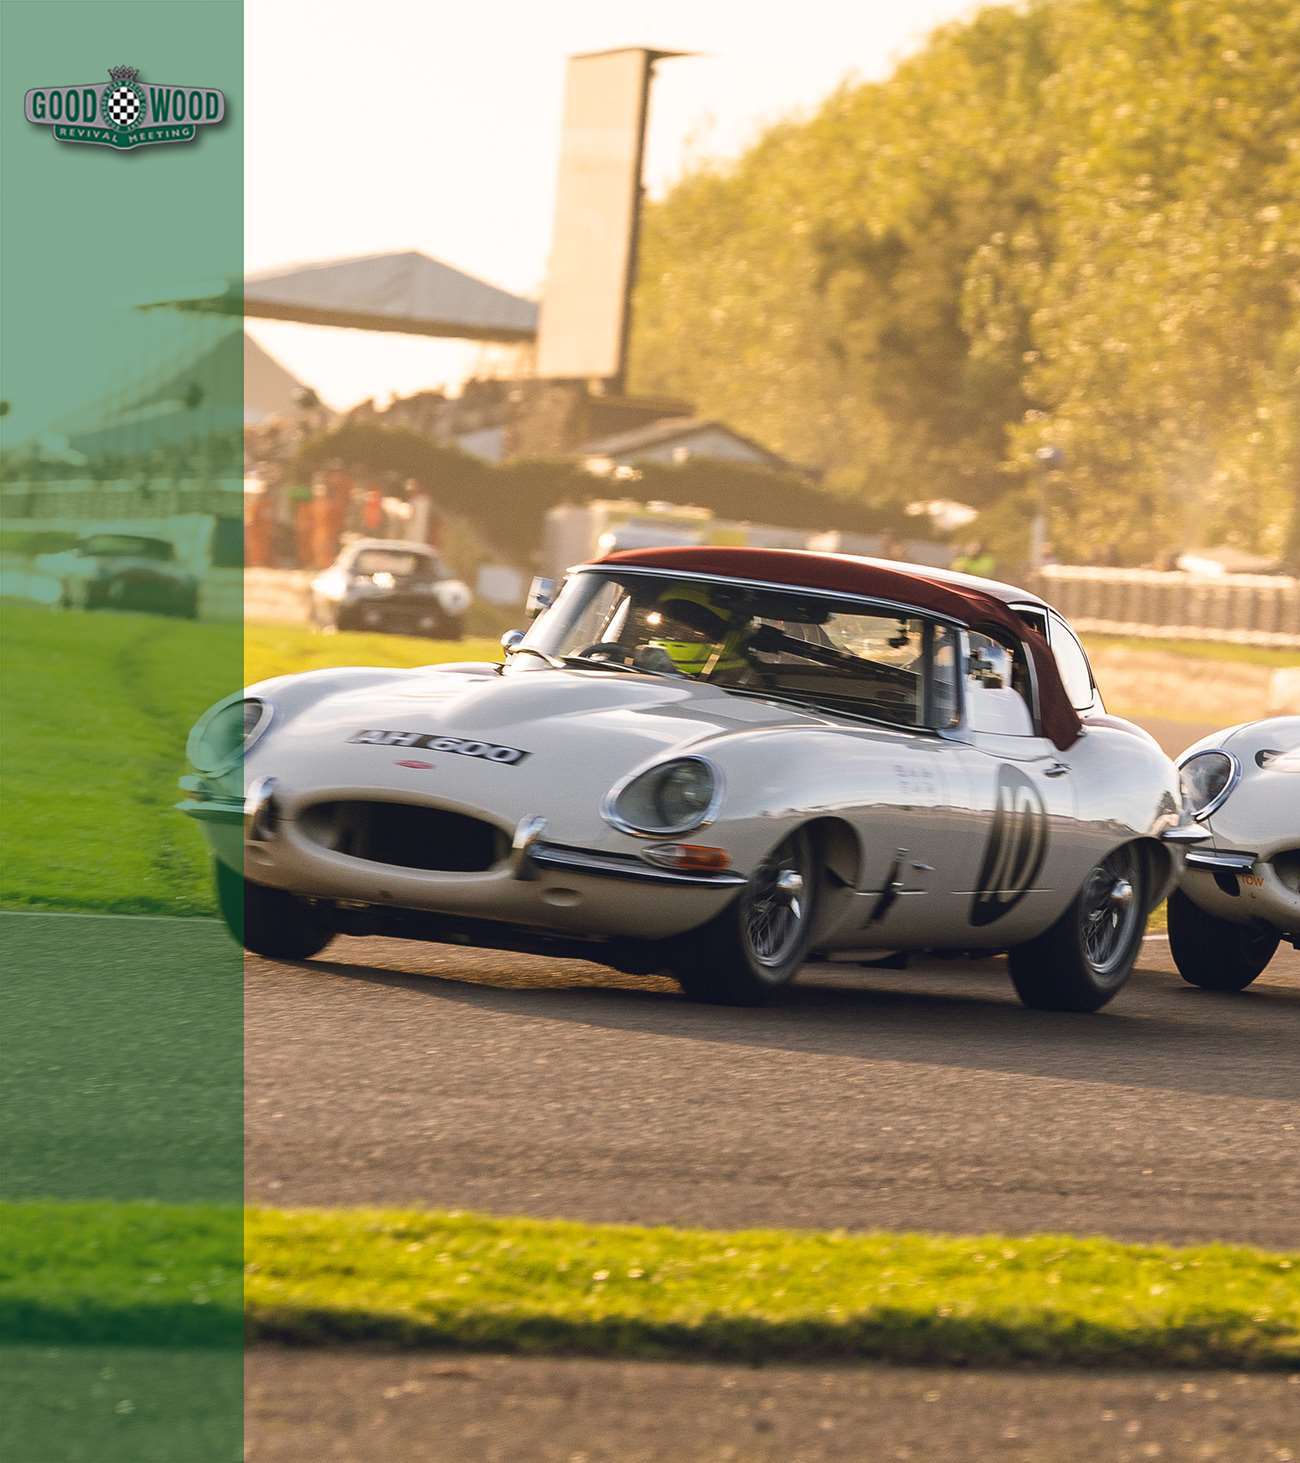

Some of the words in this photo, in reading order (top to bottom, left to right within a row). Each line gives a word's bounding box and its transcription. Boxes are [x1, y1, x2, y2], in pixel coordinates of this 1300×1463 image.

[350, 730, 423, 747] AH
[426, 737, 524, 763] 600
[978, 785, 1044, 903] 10
